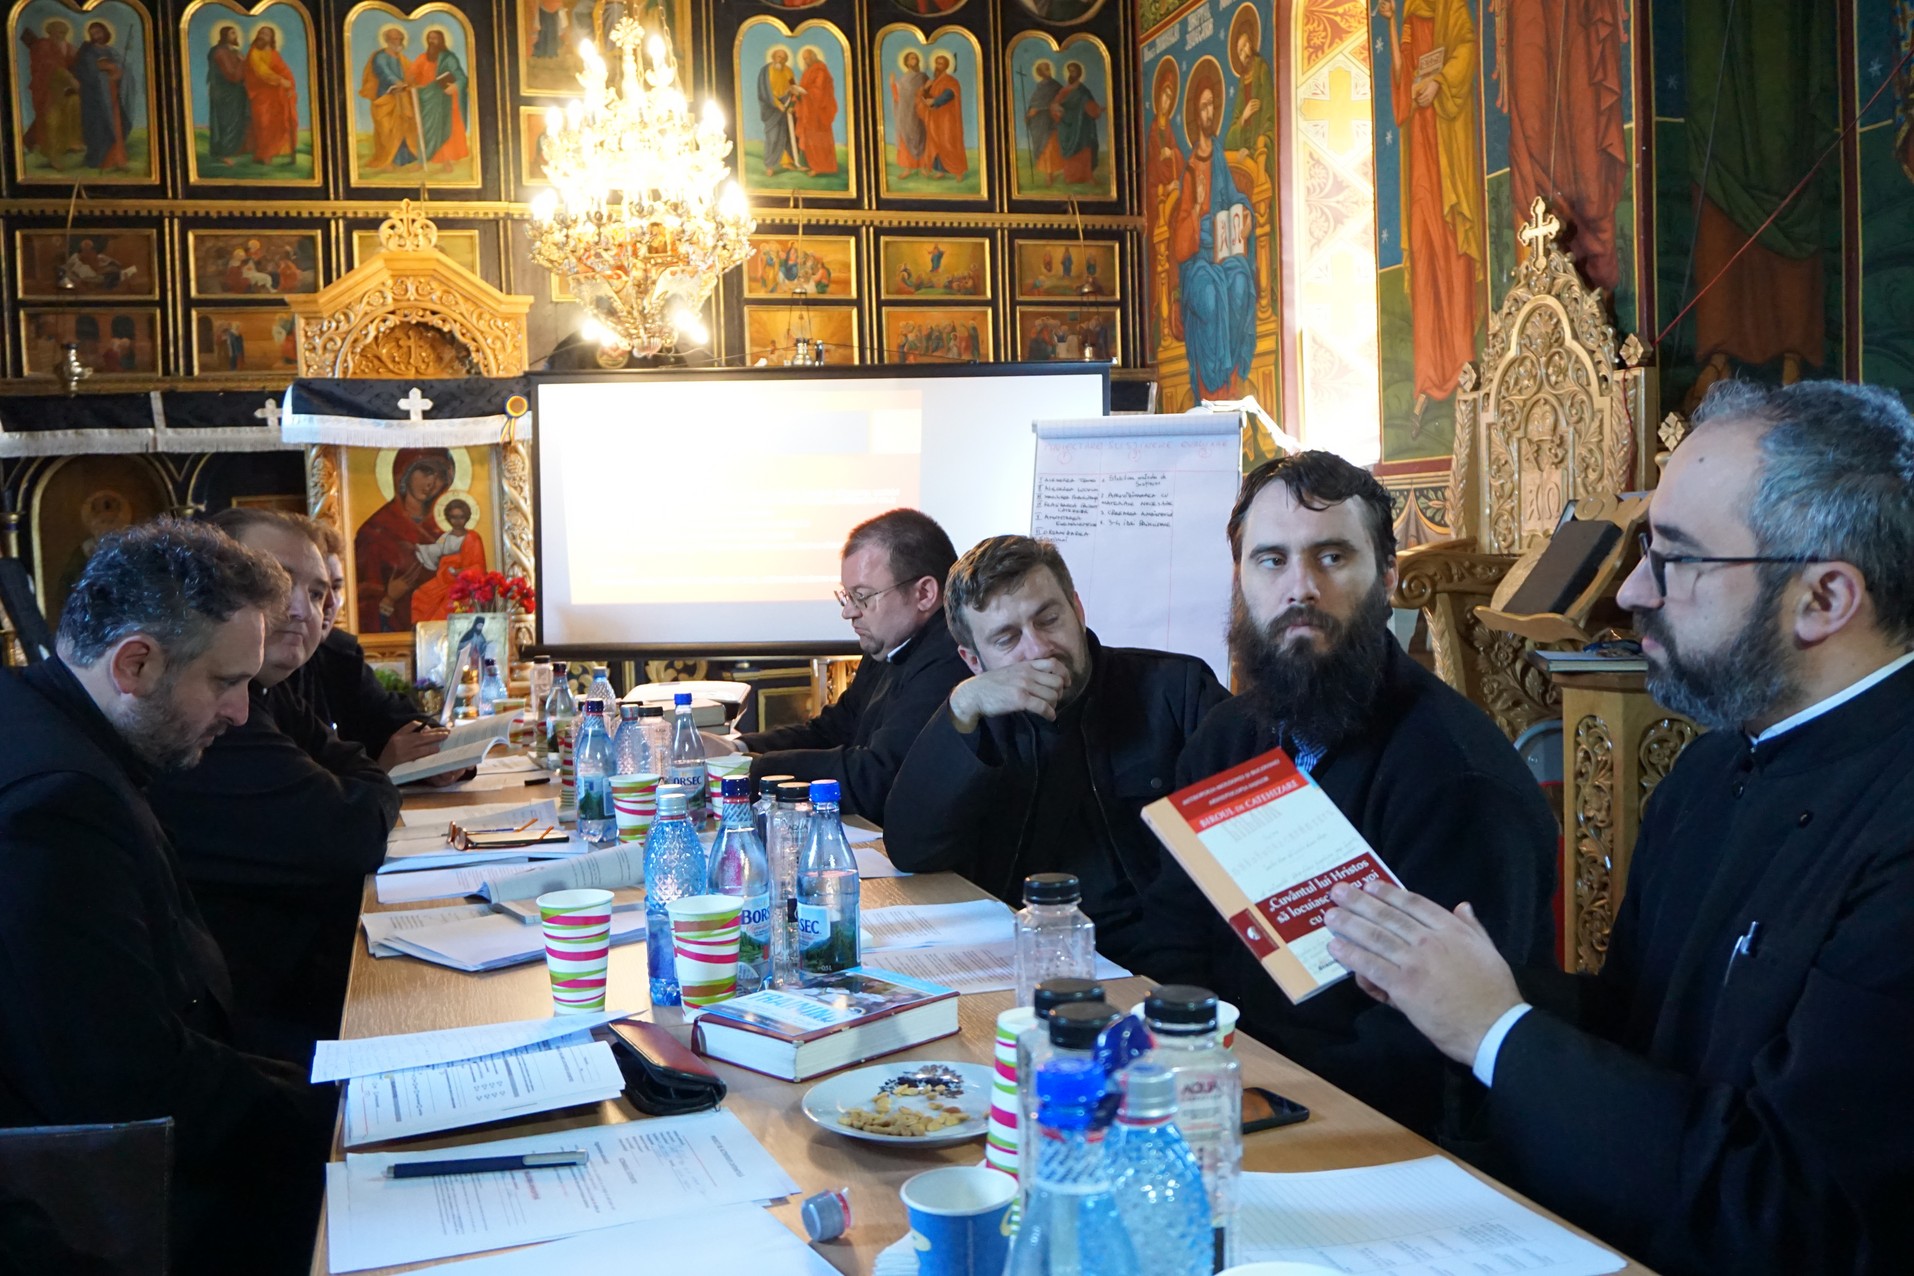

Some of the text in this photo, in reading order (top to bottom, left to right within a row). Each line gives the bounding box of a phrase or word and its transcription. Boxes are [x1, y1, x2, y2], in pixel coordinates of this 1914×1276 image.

[673, 775, 702, 786] ORSEC
[1199, 807, 1235, 829] BIROUL
[1244, 779, 1299, 808] CATEHIZARE
[1314, 875, 1333, 889] lui
[1329, 859, 1370, 883] Hristos
[1276, 910, 1291, 924] să
[1286, 892, 1332, 918] locuiasc
[1361, 869, 1380, 884] voi
[798, 918, 820, 935] SEC
[1308, 914, 1324, 926] cu
